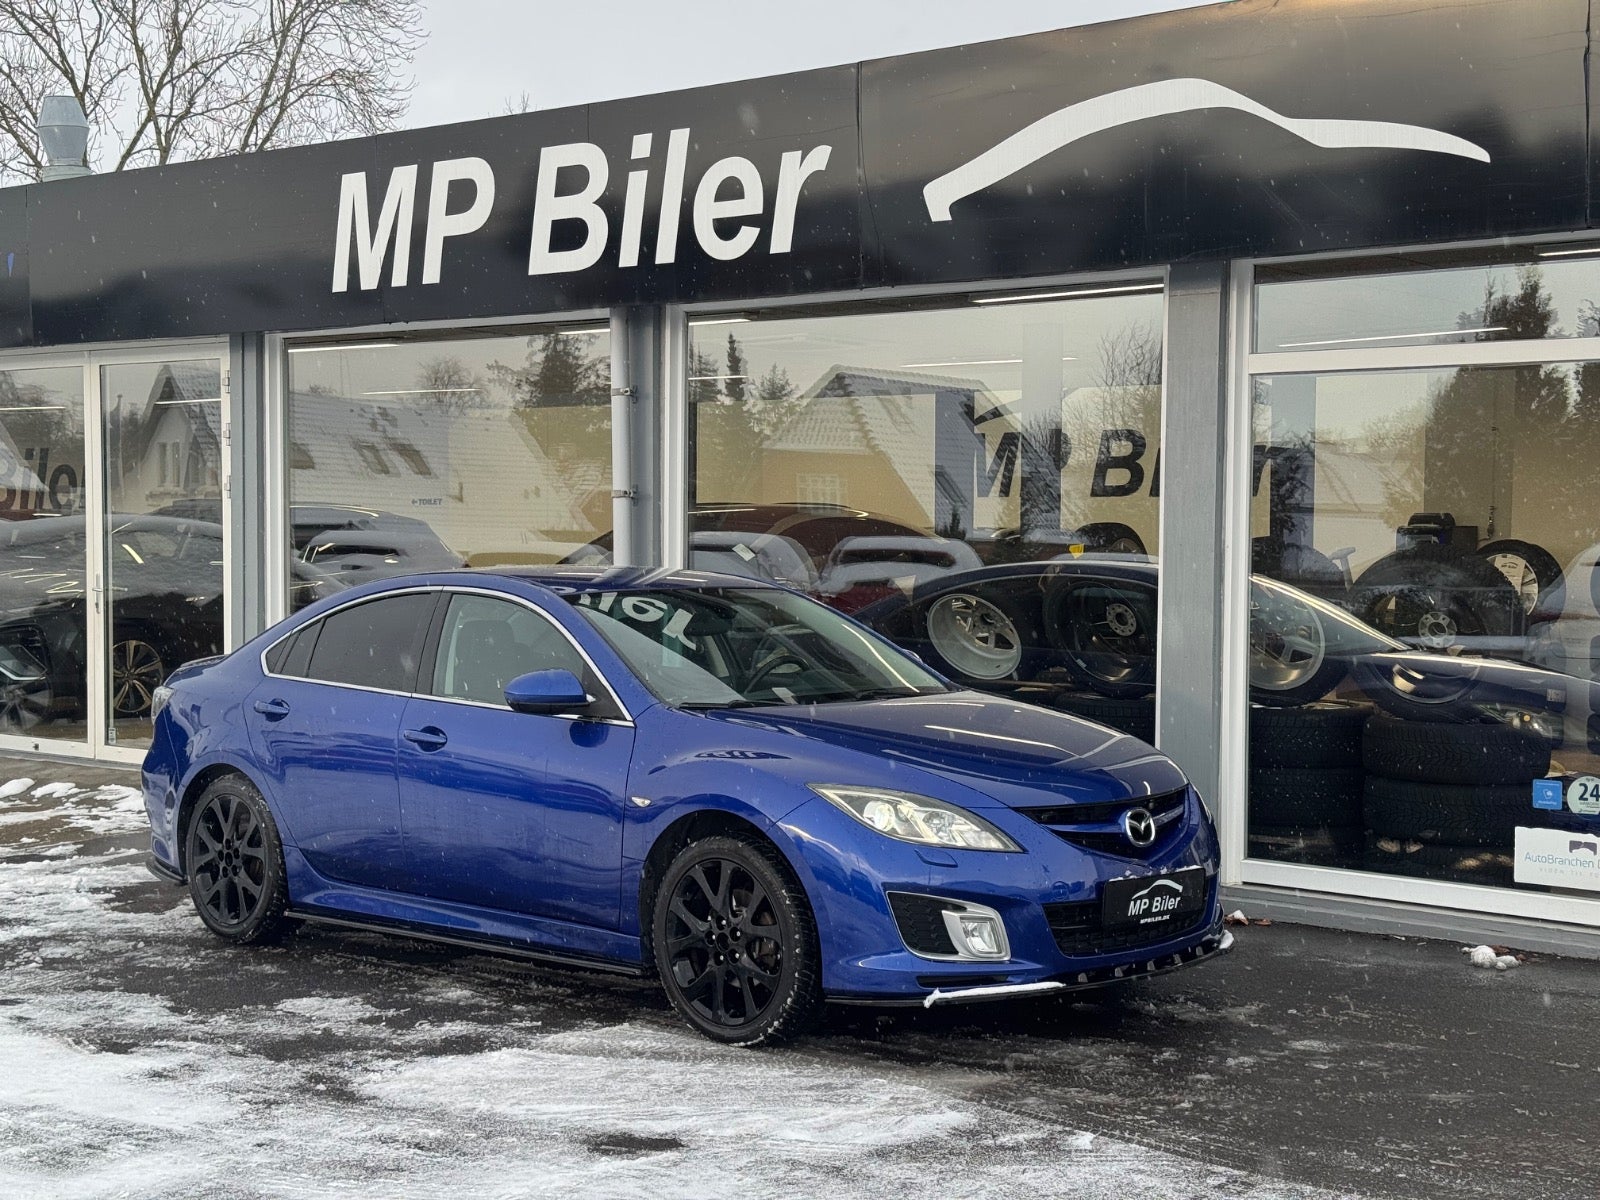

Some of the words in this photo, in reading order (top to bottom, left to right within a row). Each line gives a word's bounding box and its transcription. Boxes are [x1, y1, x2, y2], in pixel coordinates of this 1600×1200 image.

[332, 156, 495, 294] MP
[528, 127, 832, 275] Biler
[1525, 852, 1594, 867] AutoBranchen
[1129, 900, 1149, 916] MP
[1152, 896, 1180, 912] Biler
